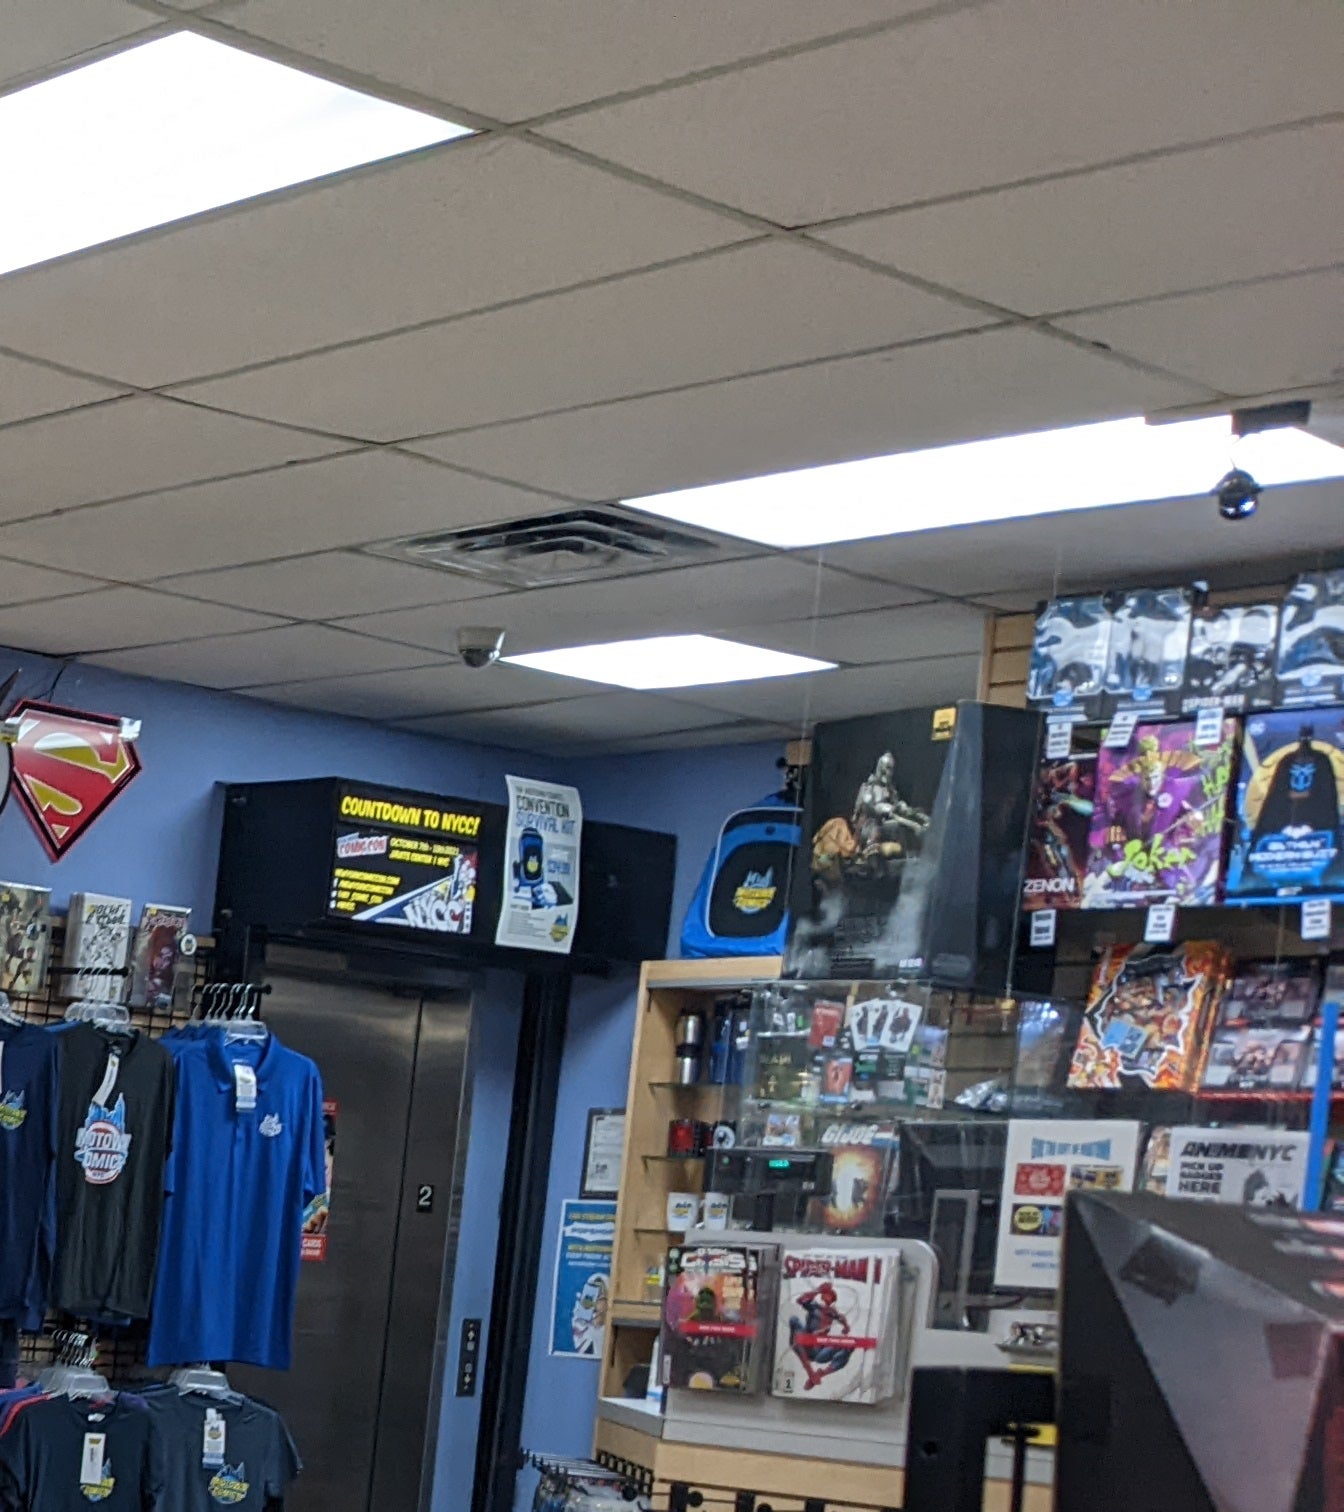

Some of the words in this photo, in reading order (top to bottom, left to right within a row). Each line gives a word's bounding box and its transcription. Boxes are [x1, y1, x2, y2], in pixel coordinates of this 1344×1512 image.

[341, 796, 422, 828] COUNTDOWN
[423, 809, 440, 829] TO
[441, 813, 481, 835] NYCC!
[515, 795, 571, 818] CONVENTION
[1024, 878, 1075, 893] ZENON
[1252, 1142, 1298, 1162] NYC
[419, 1186, 432, 1205] 2
[1179, 1182, 1222, 1195] HERE
